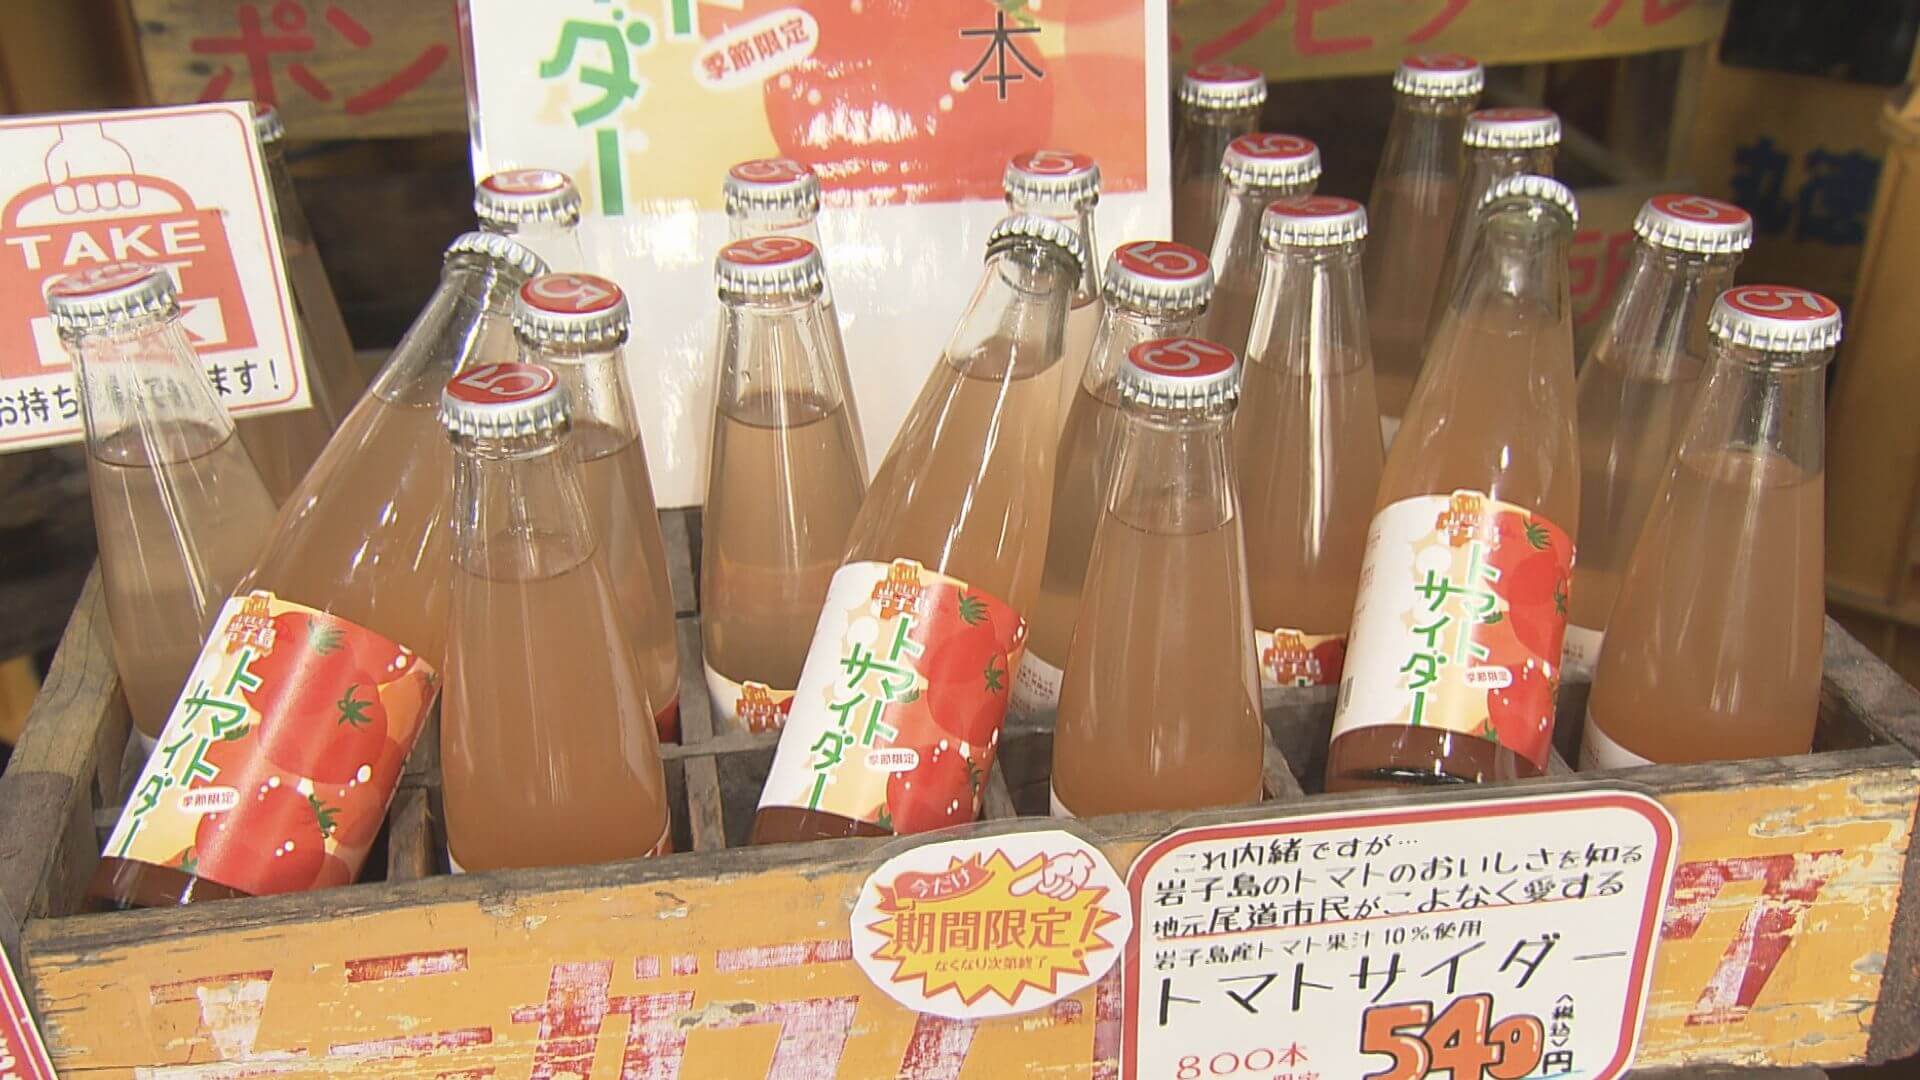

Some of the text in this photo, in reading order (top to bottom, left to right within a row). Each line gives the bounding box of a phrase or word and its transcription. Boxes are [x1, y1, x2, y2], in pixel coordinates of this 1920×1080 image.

[702, 19, 809, 80] 季節限定
[960, 10, 1043, 99] 本
[5, 219, 206, 271] TAKE
[732, 236, 805, 260] 5
[1126, 242, 1197, 274] 5
[531, 275, 611, 309] 5
[1737, 285, 1823, 313] 5
[463, 364, 544, 396] 5
[1143, 338, 1226, 372] 5
[1400, 570, 1450, 726] サイダー
[862, 617, 923, 746] トマト
[180, 650, 258, 787] トマト
[808, 643, 872, 810] サイダー
[119, 680, 210, 857] サイダー
[910, 867, 971, 897] 今だけ
[1155, 842, 1642, 906] 岩子島のトマトのおいしさを知る
[894, 905, 1098, 959] 期間限定！
[1154, 871, 1625, 938] 地元尾道市民がこよなく愛する
[934, 956, 1049, 973] なくなり次第終了
[1158, 932, 1627, 1026] トマトサイダー
[1176, 1041, 1308, 1080] 800本
[1360, 992, 1544, 1080] 540
